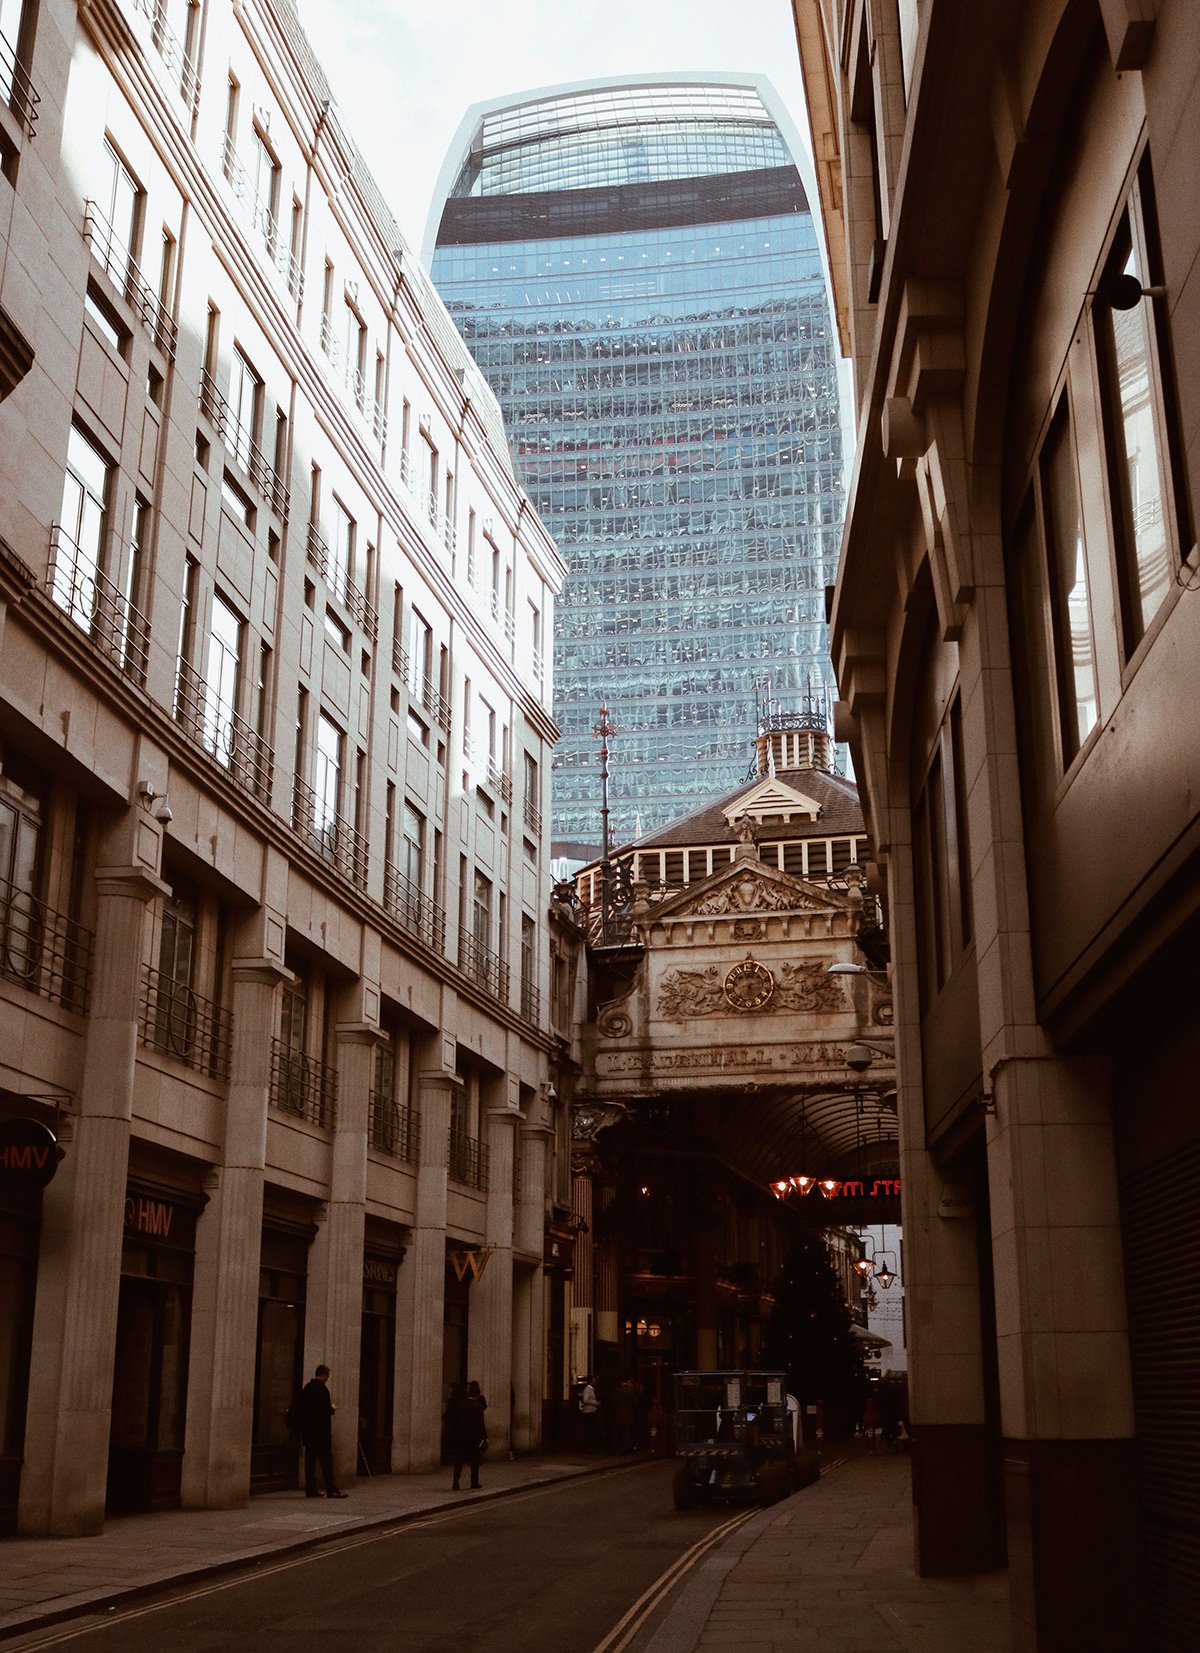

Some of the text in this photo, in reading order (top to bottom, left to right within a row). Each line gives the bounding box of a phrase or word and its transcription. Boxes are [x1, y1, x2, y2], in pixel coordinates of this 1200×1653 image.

[608, 1048, 773, 1072] LEADENHALL
[138, 1198, 173, 1238] HMV
[449, 1250, 492, 1283] W
